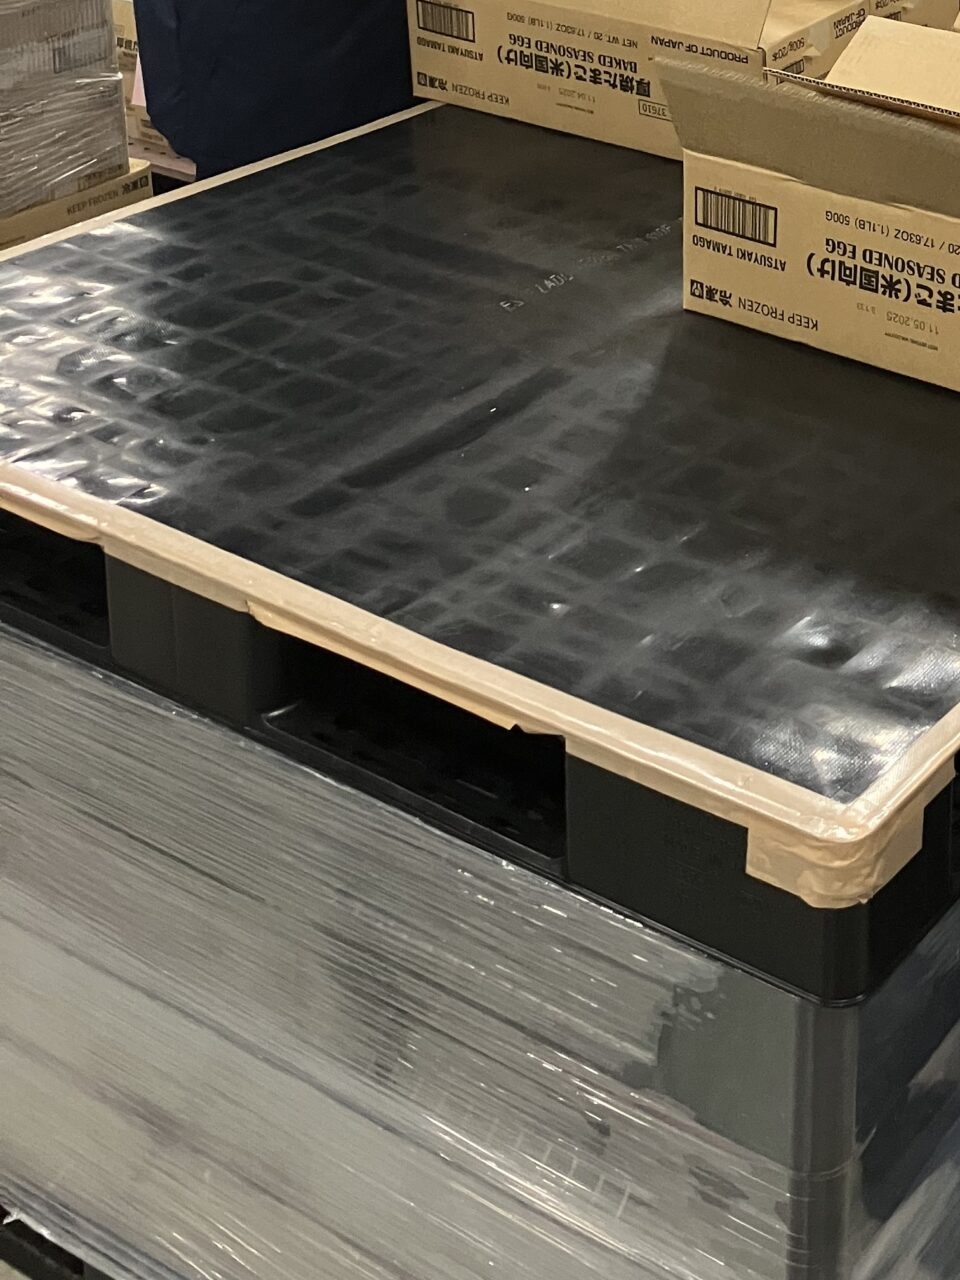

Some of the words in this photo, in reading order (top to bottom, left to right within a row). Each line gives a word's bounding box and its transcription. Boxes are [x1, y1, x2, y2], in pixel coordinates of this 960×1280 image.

[832, 12, 855, 30] JAPAN
[853, 7, 866, 22] OF
[416, 36, 446, 52] TAMAGO
[508, 33, 532, 48] EGG
[593, 31, 603, 41] 20
[605, 34, 619, 44] WT.
[622, 38, 638, 49] NET
[651, 35, 683, 49] JAPAN
[447, 44, 484, 61] ATSUYAKI
[535, 39, 594, 63] SEASONED
[685, 45, 698, 53] OF
[700, 49, 748, 64] PRODUCT
[598, 54, 638, 73] BAKED
[452, 82, 485, 100] FROZEN
[487, 90, 510, 106] KEEP
[642, 103, 666, 117] 37610
[825, 210, 851, 227] 500G
[854, 217, 890, 238] (1.1LB)
[692, 234, 734, 257] TAMAGO
[895, 228, 935, 248] 17.63OZ
[938, 240, 945, 250] /
[825, 237, 857, 259] EGG
[947, 243, 960, 256] 20
[736, 248, 787, 272] ATSUYAKI
[862, 249, 946, 284] SEASONED
[704, 284, 733, 308] 冷凍
[738, 297, 785, 321] FROZEN
[787, 308, 818, 332] KEEP
